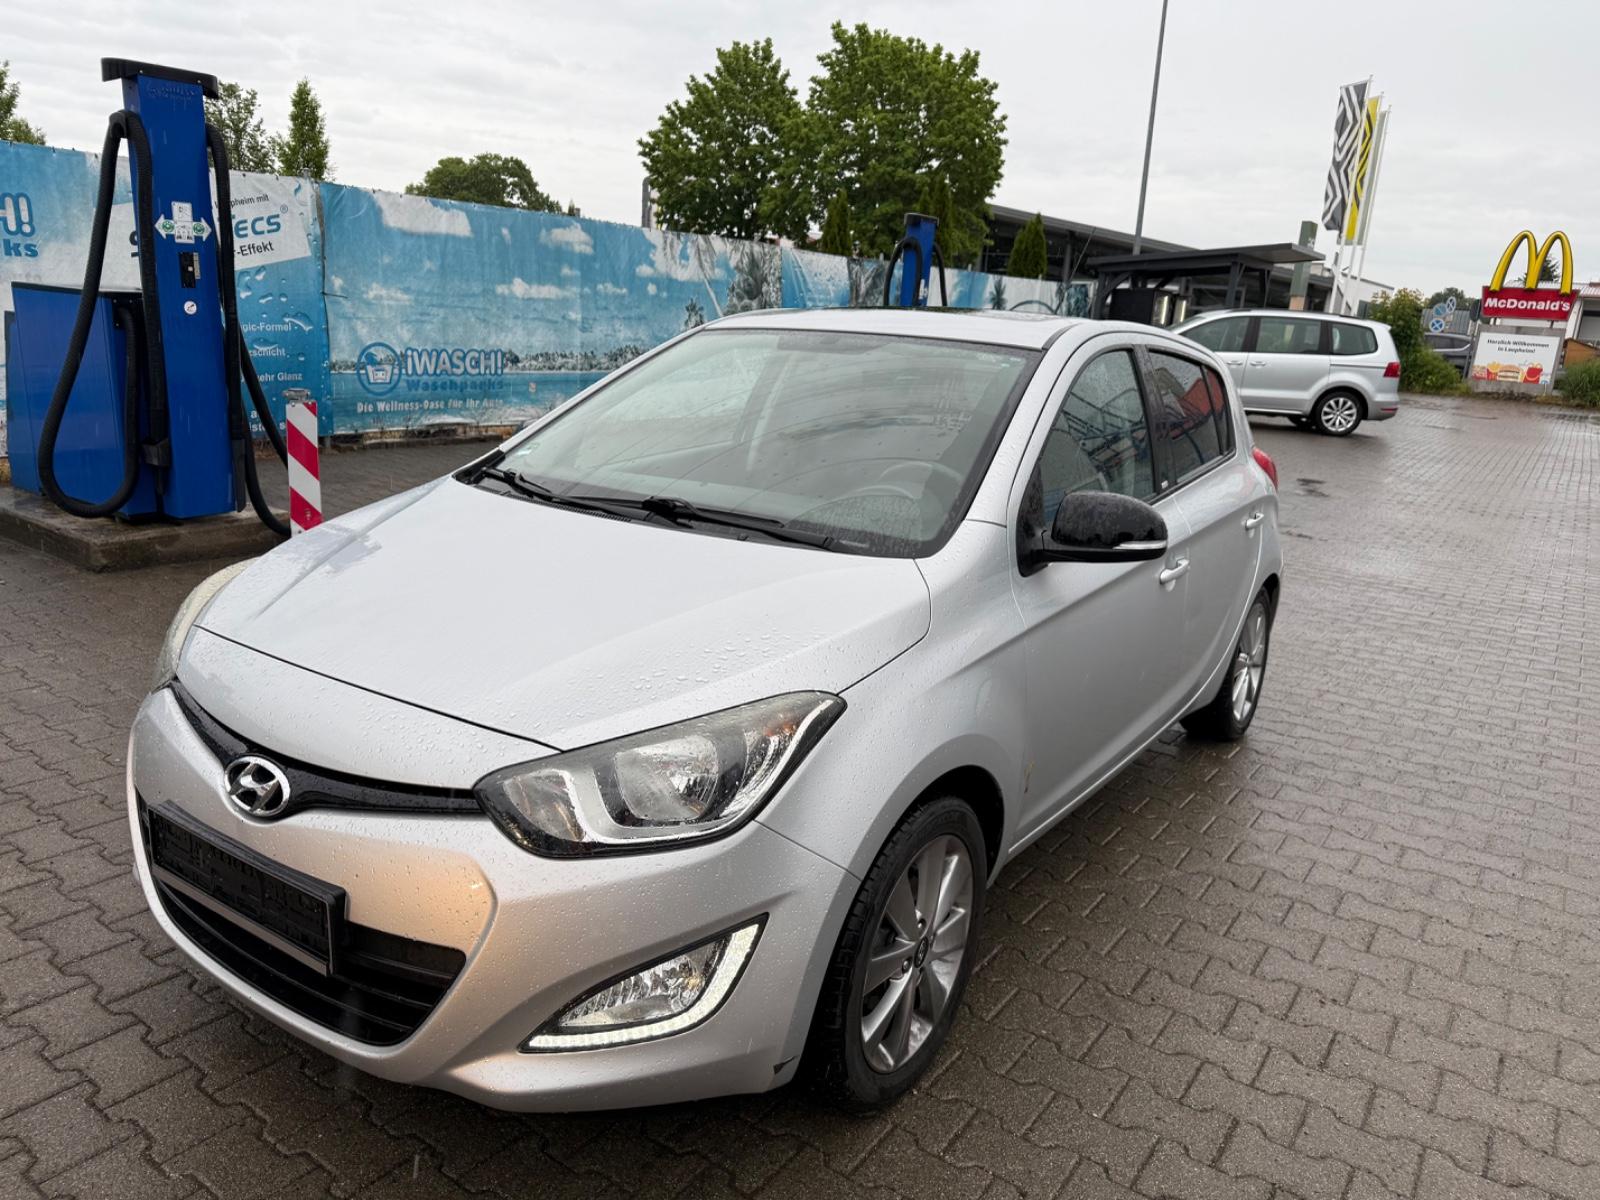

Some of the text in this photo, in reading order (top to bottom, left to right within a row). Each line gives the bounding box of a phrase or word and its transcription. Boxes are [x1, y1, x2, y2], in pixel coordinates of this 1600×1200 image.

[256, 194, 270, 203] mit
[2, 239, 39, 258] ks
[233, 241, 275, 257] -Effekt
[1484, 297, 1571, 311] McDonald's
[240, 321, 292, 333] gic-Formel
[404, 347, 504, 377] iWASCH!
[277, 372, 303, 382] Glanz
[405, 378, 504, 393] Waschparks
[357, 401, 374, 413] Die
[466, 398, 480, 408] Ihr
